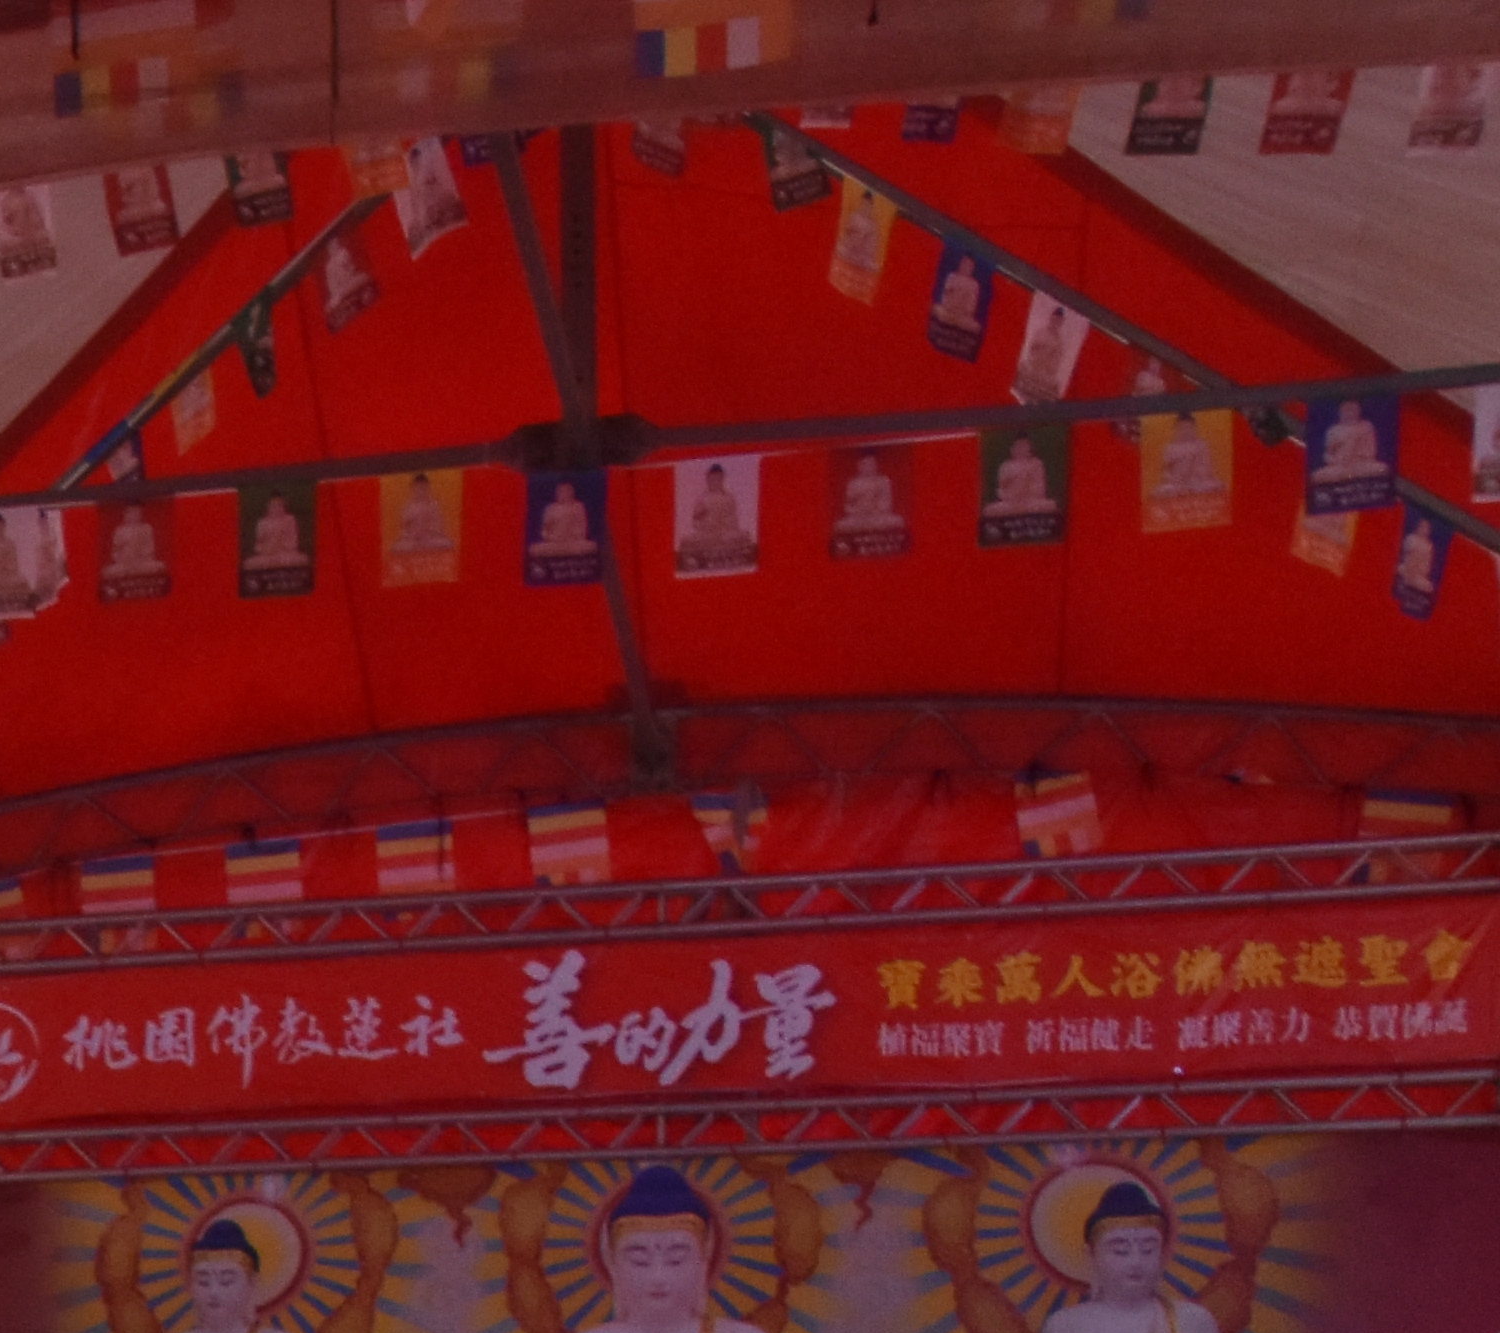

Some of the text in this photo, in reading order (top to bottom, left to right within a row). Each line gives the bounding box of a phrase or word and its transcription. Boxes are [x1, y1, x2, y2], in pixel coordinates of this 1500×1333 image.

[61, 994, 465, 1089] 桃園佛教蓮社
[483, 949, 838, 1090] 善的力量
